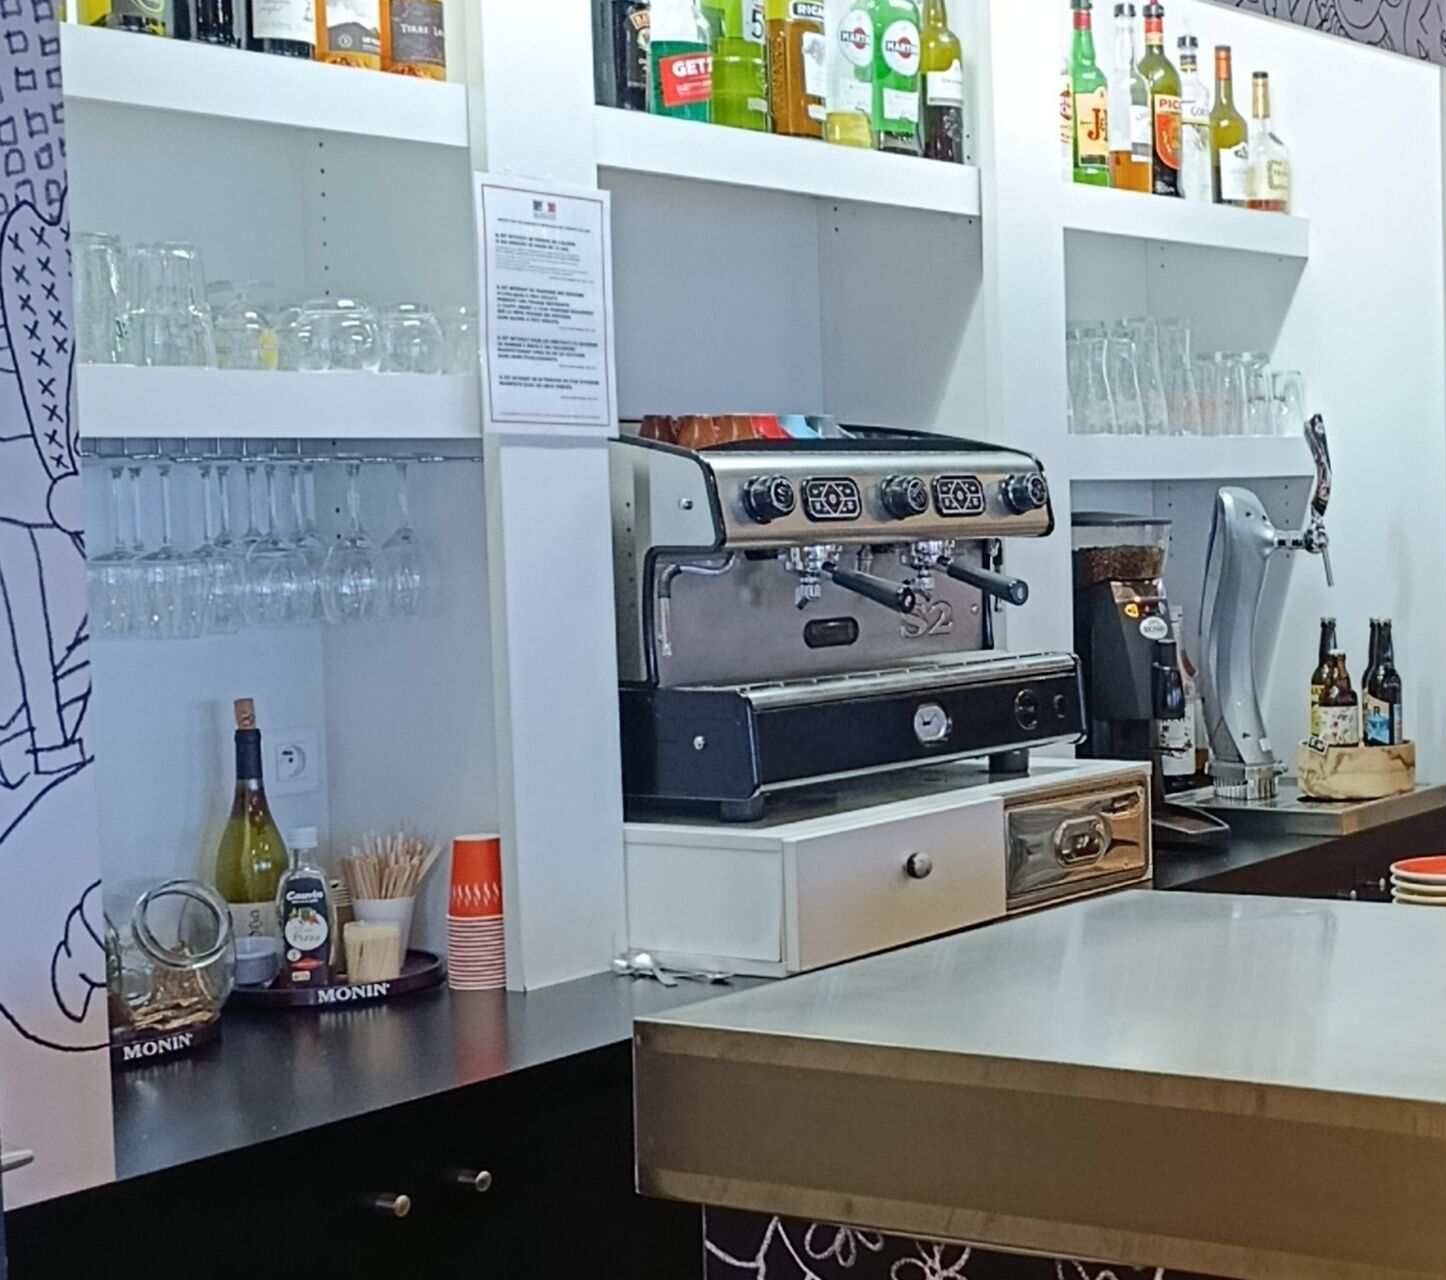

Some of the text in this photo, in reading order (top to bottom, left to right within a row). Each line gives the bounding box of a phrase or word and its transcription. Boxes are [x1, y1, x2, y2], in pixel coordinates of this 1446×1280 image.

[796, 4, 825, 19] RICA
[1159, 98, 1181, 111] PIC
[318, 983, 390, 1004] MONIN
[123, 1033, 193, 1061] MONIN
